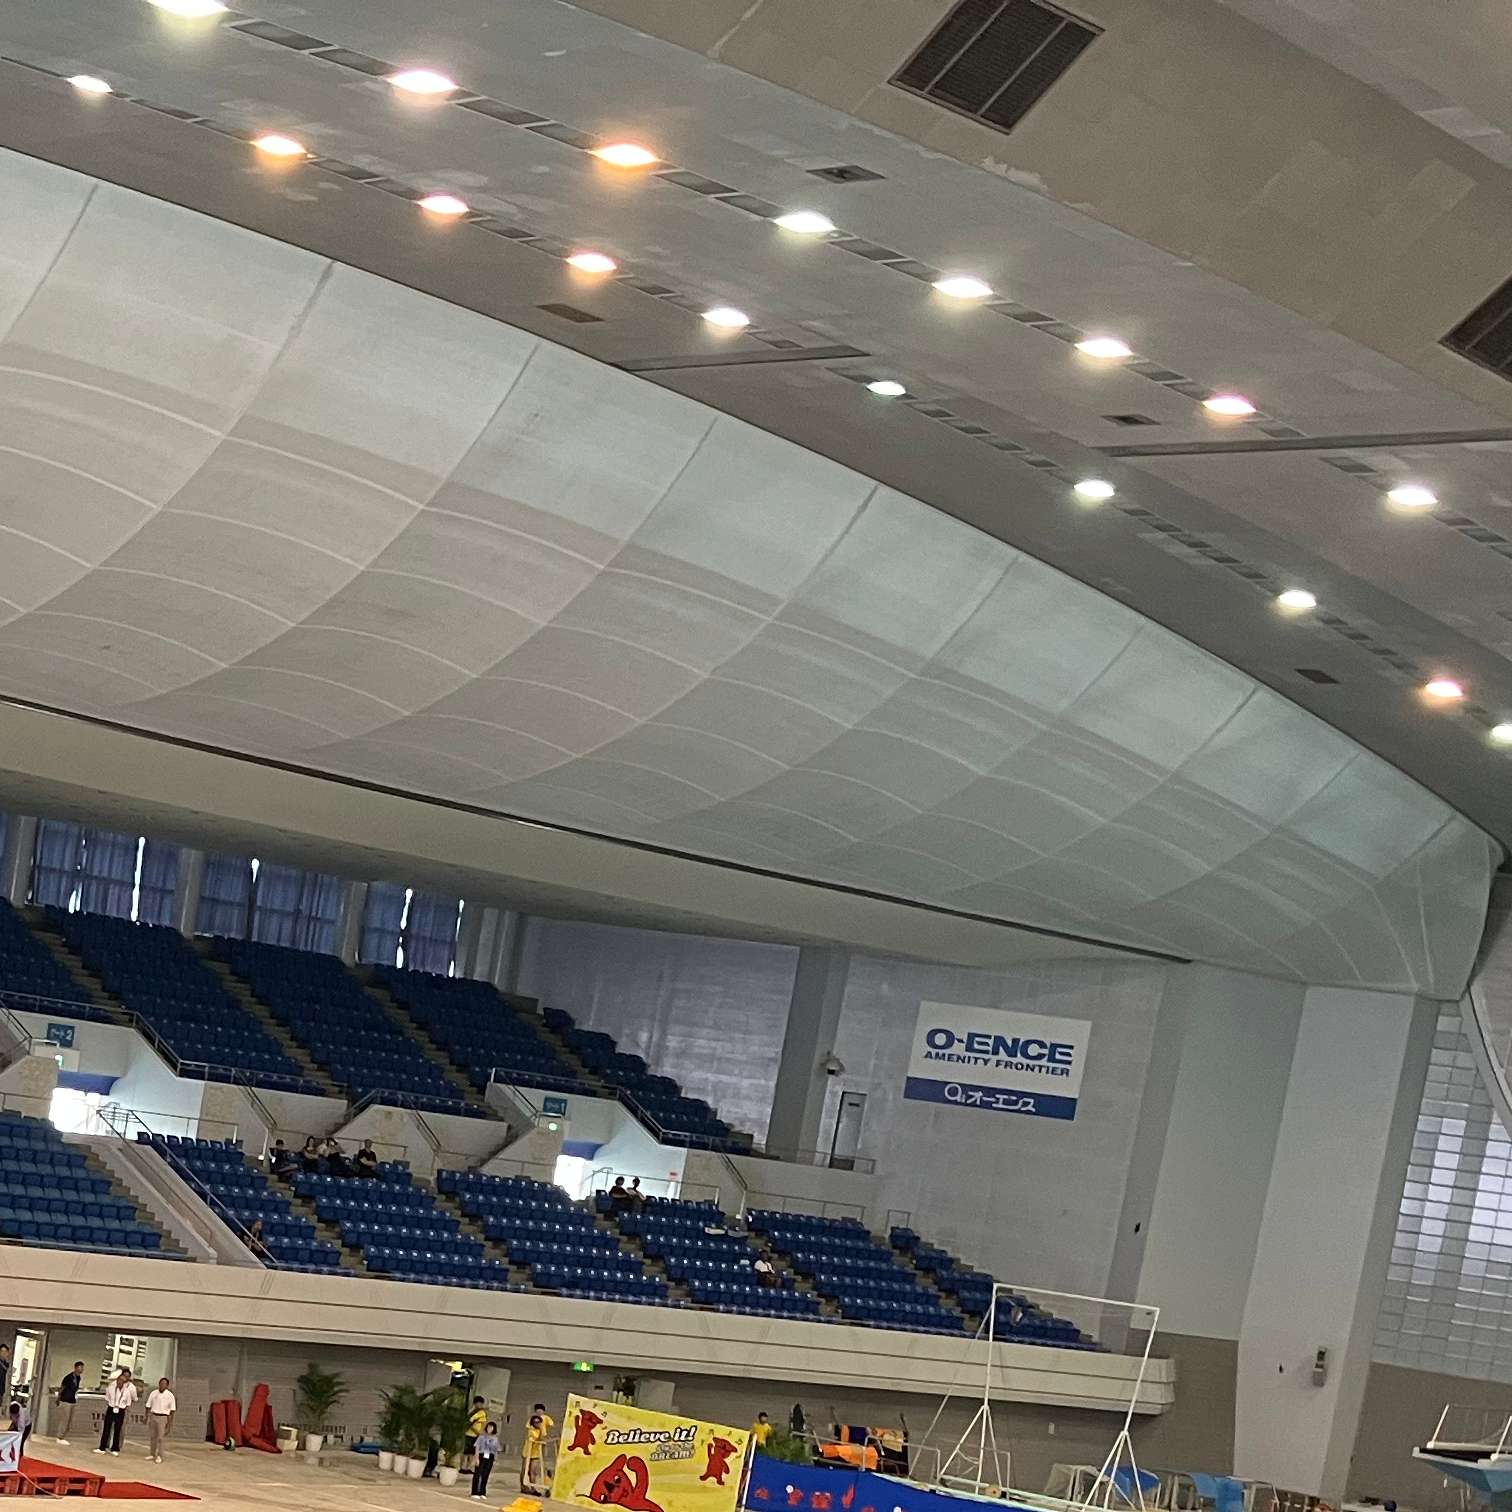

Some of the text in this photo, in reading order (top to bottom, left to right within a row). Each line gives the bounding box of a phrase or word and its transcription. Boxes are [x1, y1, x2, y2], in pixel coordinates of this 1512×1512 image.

[926, 1028, 1075, 1066] O-ENCE
[924, 1051, 1070, 1078] AMENITY FRONTIER
[604, 1425, 697, 1445] Believe it!
